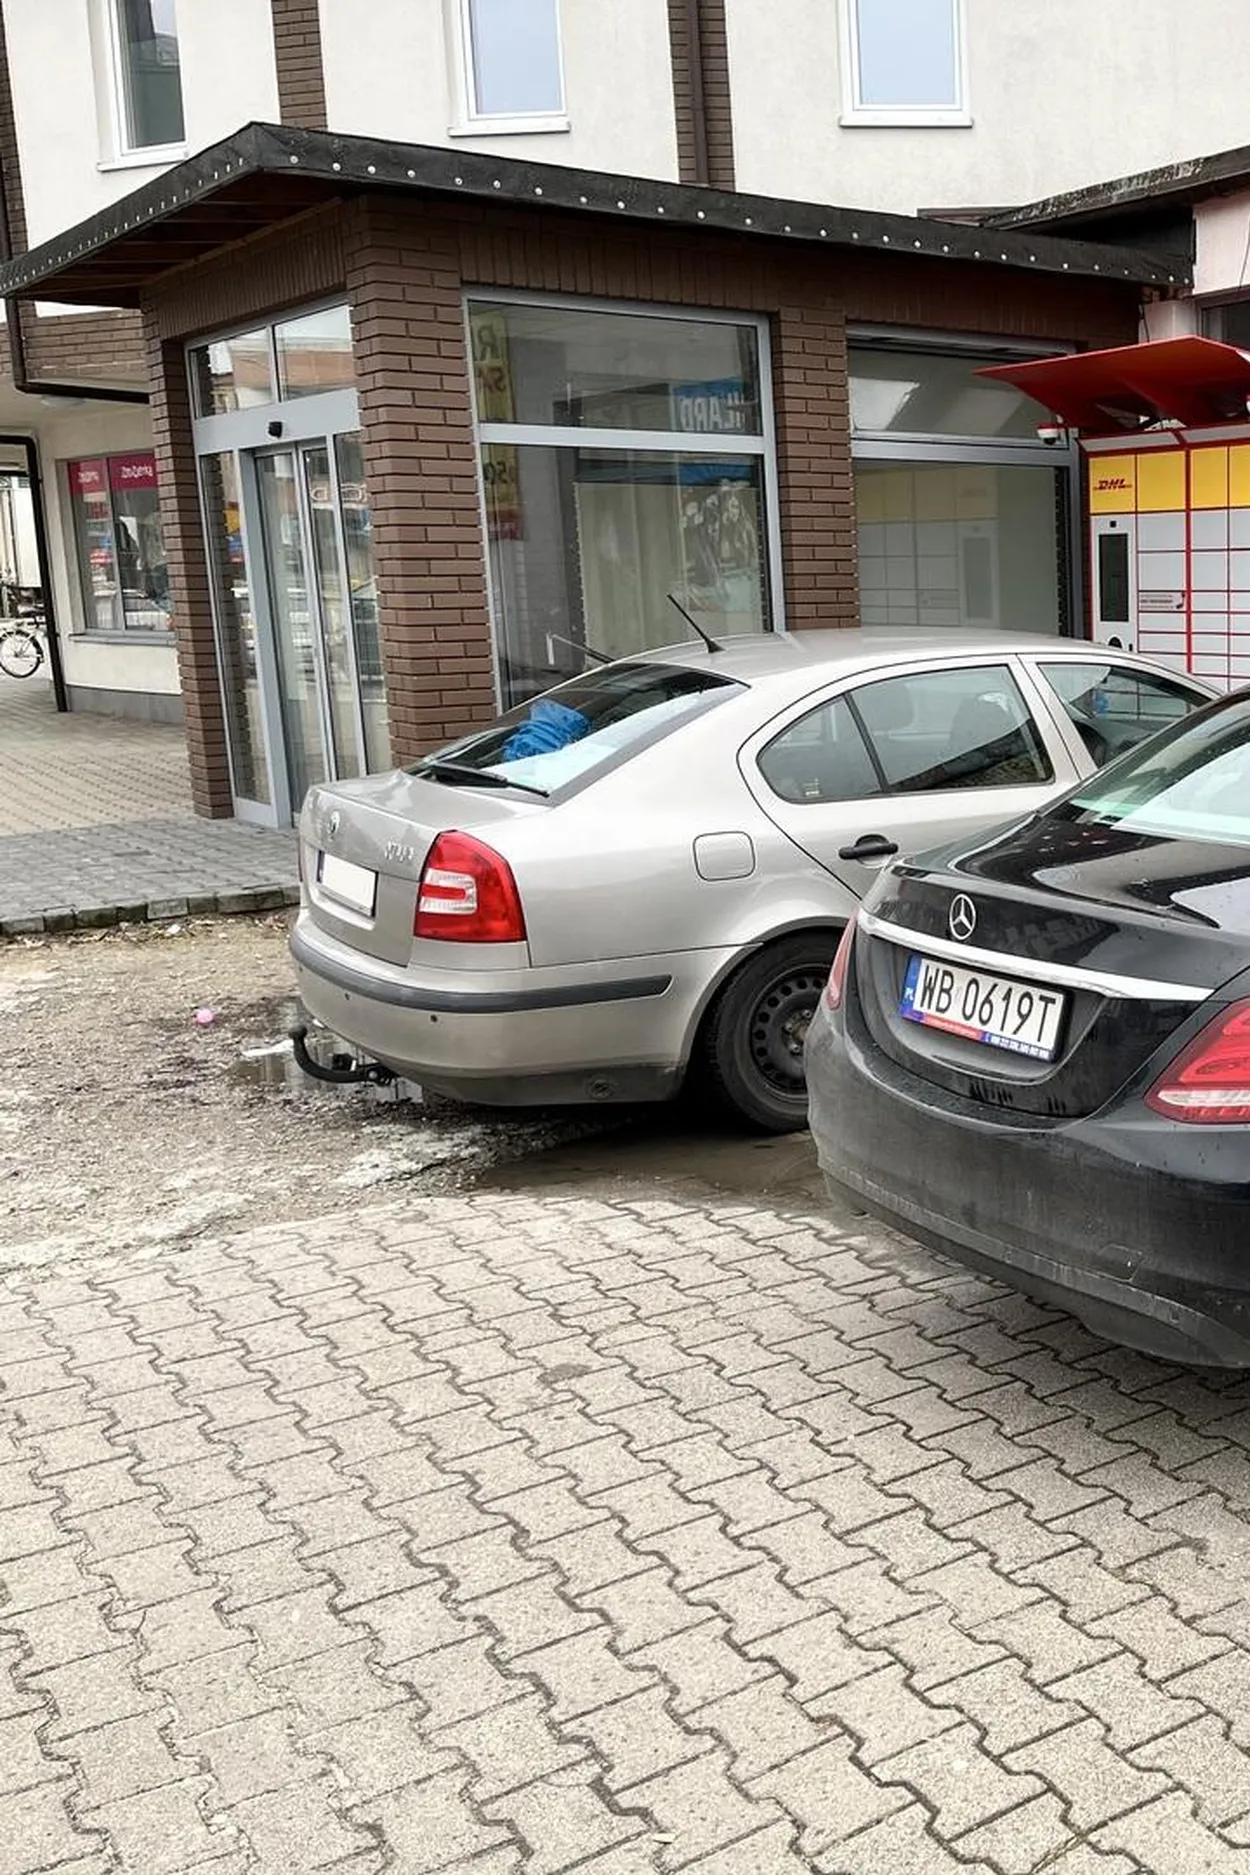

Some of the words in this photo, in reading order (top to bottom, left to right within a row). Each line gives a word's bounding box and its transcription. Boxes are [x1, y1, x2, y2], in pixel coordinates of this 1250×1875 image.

[1097, 478, 1127, 491] DHL
[919, 964, 955, 1015] WB
[961, 977, 1057, 1043] 0619T
